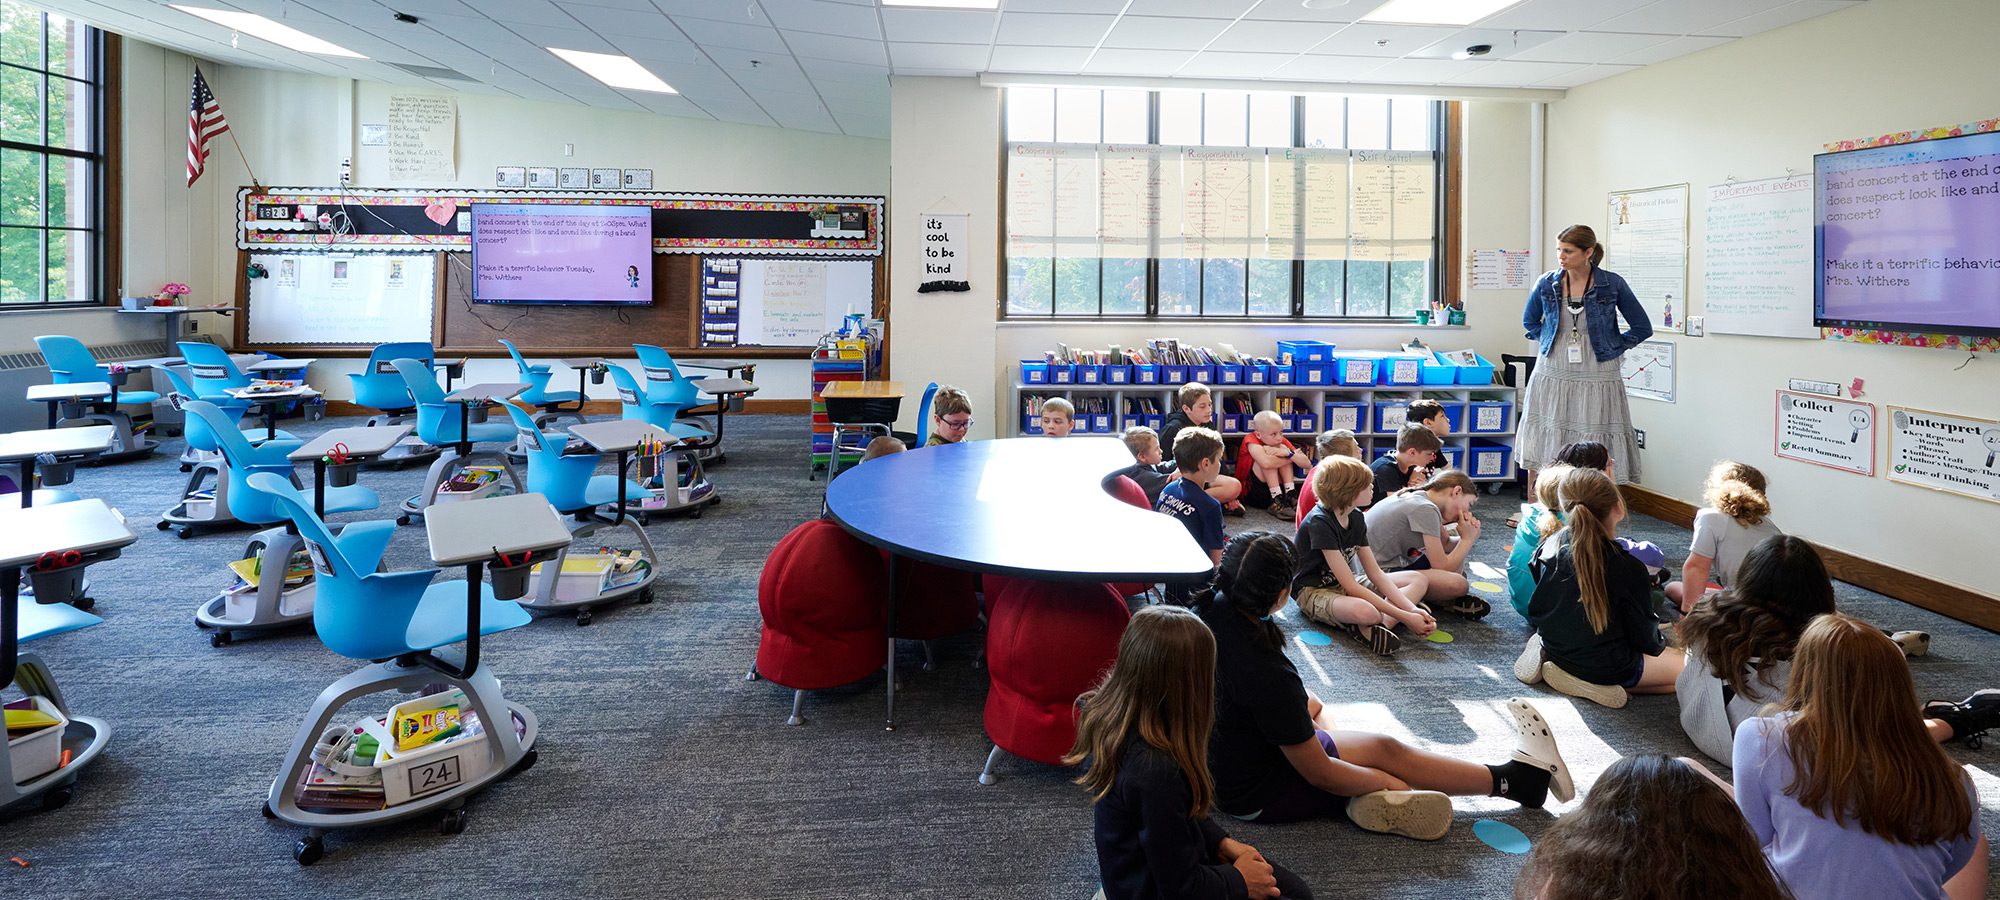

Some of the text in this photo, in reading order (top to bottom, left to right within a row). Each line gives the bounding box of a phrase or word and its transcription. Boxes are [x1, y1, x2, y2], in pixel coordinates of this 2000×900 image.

[1826, 178, 1855, 191] band
[1857, 172, 1909, 188] concert
[1912, 170, 1929, 182] at
[1932, 167, 1958, 181] the
[1961, 164, 1989, 178] end
[1713, 179, 1809, 199] IMPORTANT EVENTS
[1826, 181, 2000, 207] does respect look like and
[1826, 207, 1881, 222] concert?
[478, 218, 494, 226] band
[544, 219, 555, 227] end
[556, 219, 564, 227] of
[566, 219, 577, 227] the
[579, 220, 590, 228] day
[628, 220, 647, 228] What
[926, 218, 942, 230] it's
[494, 228, 519, 236] respect
[535, 228, 546, 236] like
[548, 228, 559, 236] and
[560, 229, 579, 237] sound
[580, 229, 592, 237] like
[594, 229, 614, 238] during
[620, 229, 636, 237] band
[926, 232, 950, 242] cool
[925, 246, 955, 258] to be
[511, 264, 535, 272] terrific
[926, 263, 951, 274] kind
[1826, 259, 1859, 270] Make
[1862, 258, 1874, 270] it
[1876, 261, 1884, 270] a
[1887, 257, 1940, 270] terrific
[1826, 274, 1911, 287] Mrs. Withers
[1793, 399, 1834, 413] Collect
[1792, 414, 1822, 423] Character
[1792, 420, 1814, 429] Setting
[1792, 425, 1821, 435] Problems
[1909, 416, 1981, 435] Interpret
[1792, 431, 1846, 446] Important Events
[1926, 433, 1964, 444] Repeated
[1791, 444, 1853, 461] Retell Summary
[1909, 449, 1964, 464] Author's Craft
[1909, 456, 1941, 466] Author's
[1908, 467, 1928, 476] Line
[1942, 473, 1990, 490] Thinking
[423, 763, 451, 787] 24
